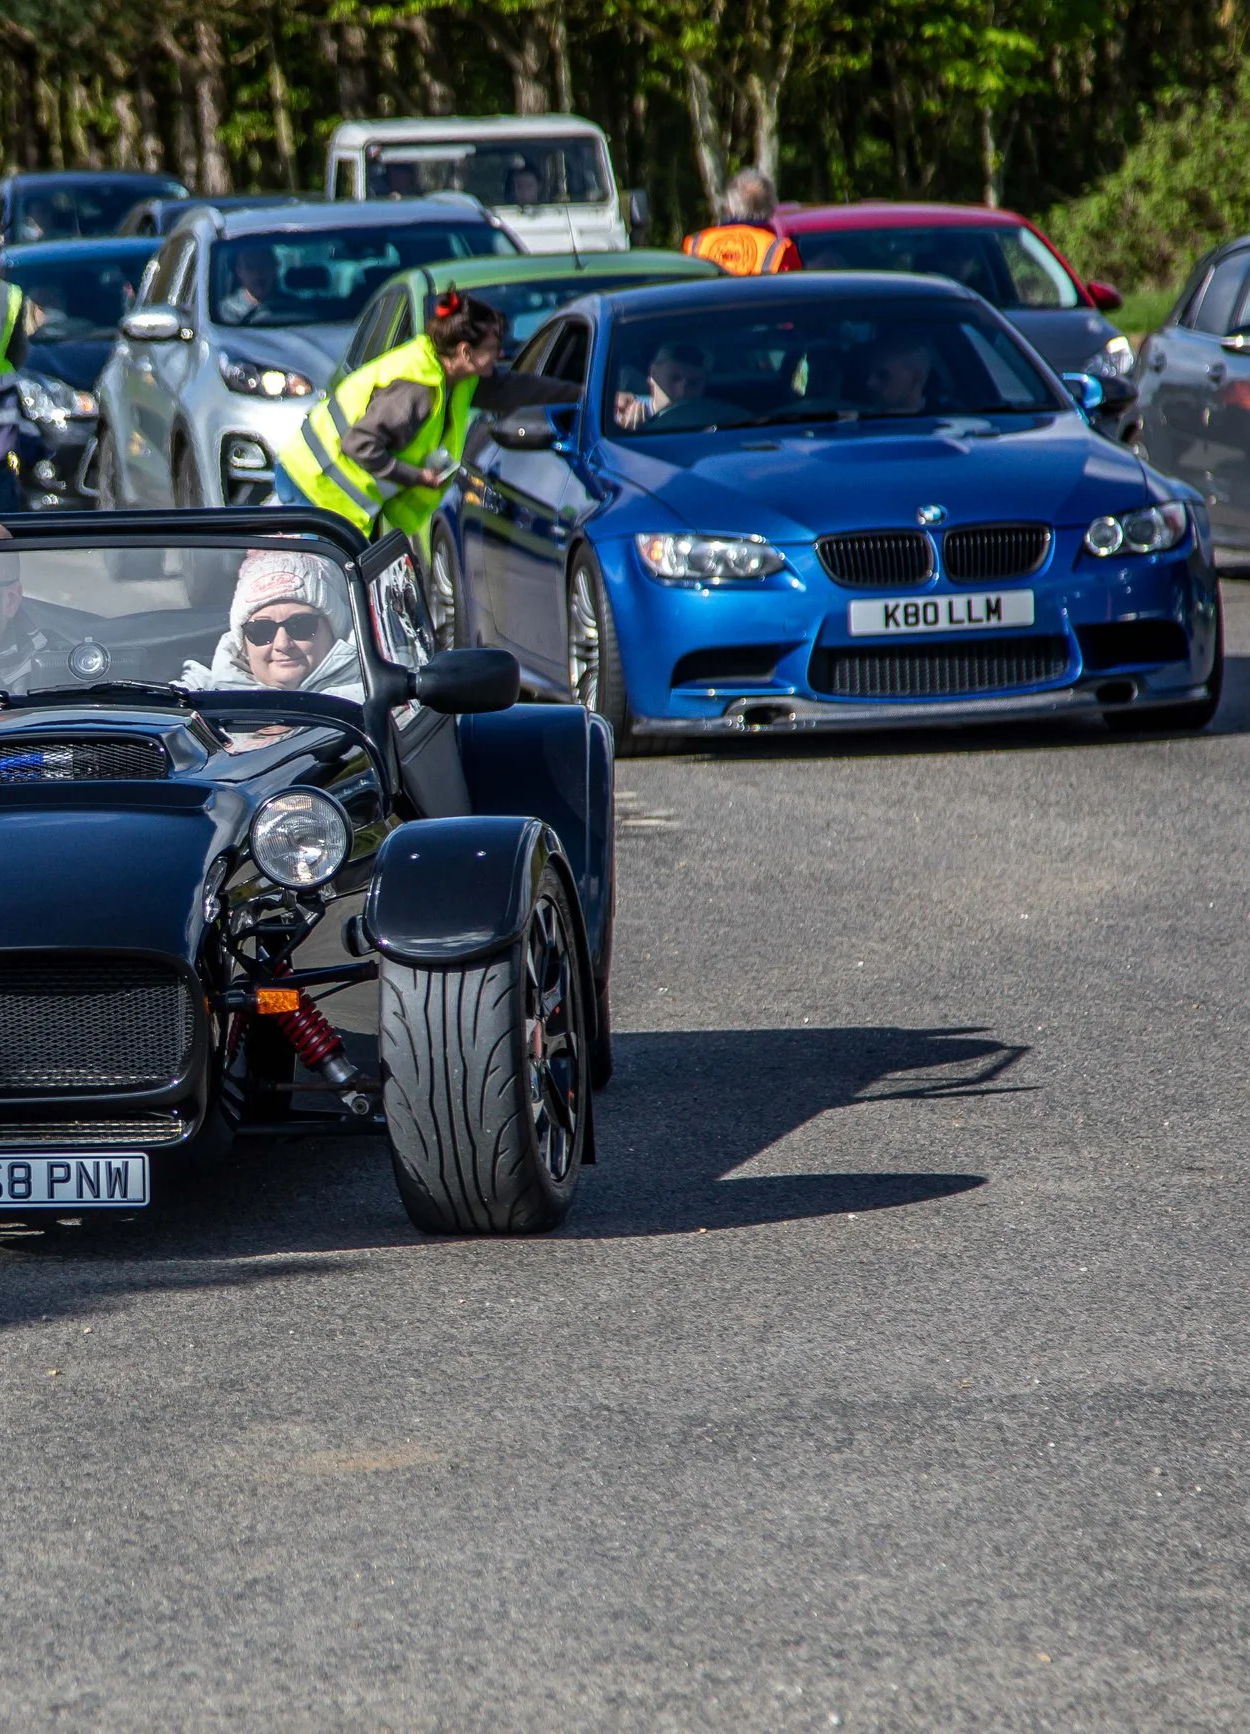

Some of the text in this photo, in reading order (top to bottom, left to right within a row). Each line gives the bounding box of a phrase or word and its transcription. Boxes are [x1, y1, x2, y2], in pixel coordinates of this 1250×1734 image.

[884, 597, 1002, 629] K80 LLM
[46, 1160, 129, 1200] PNW
